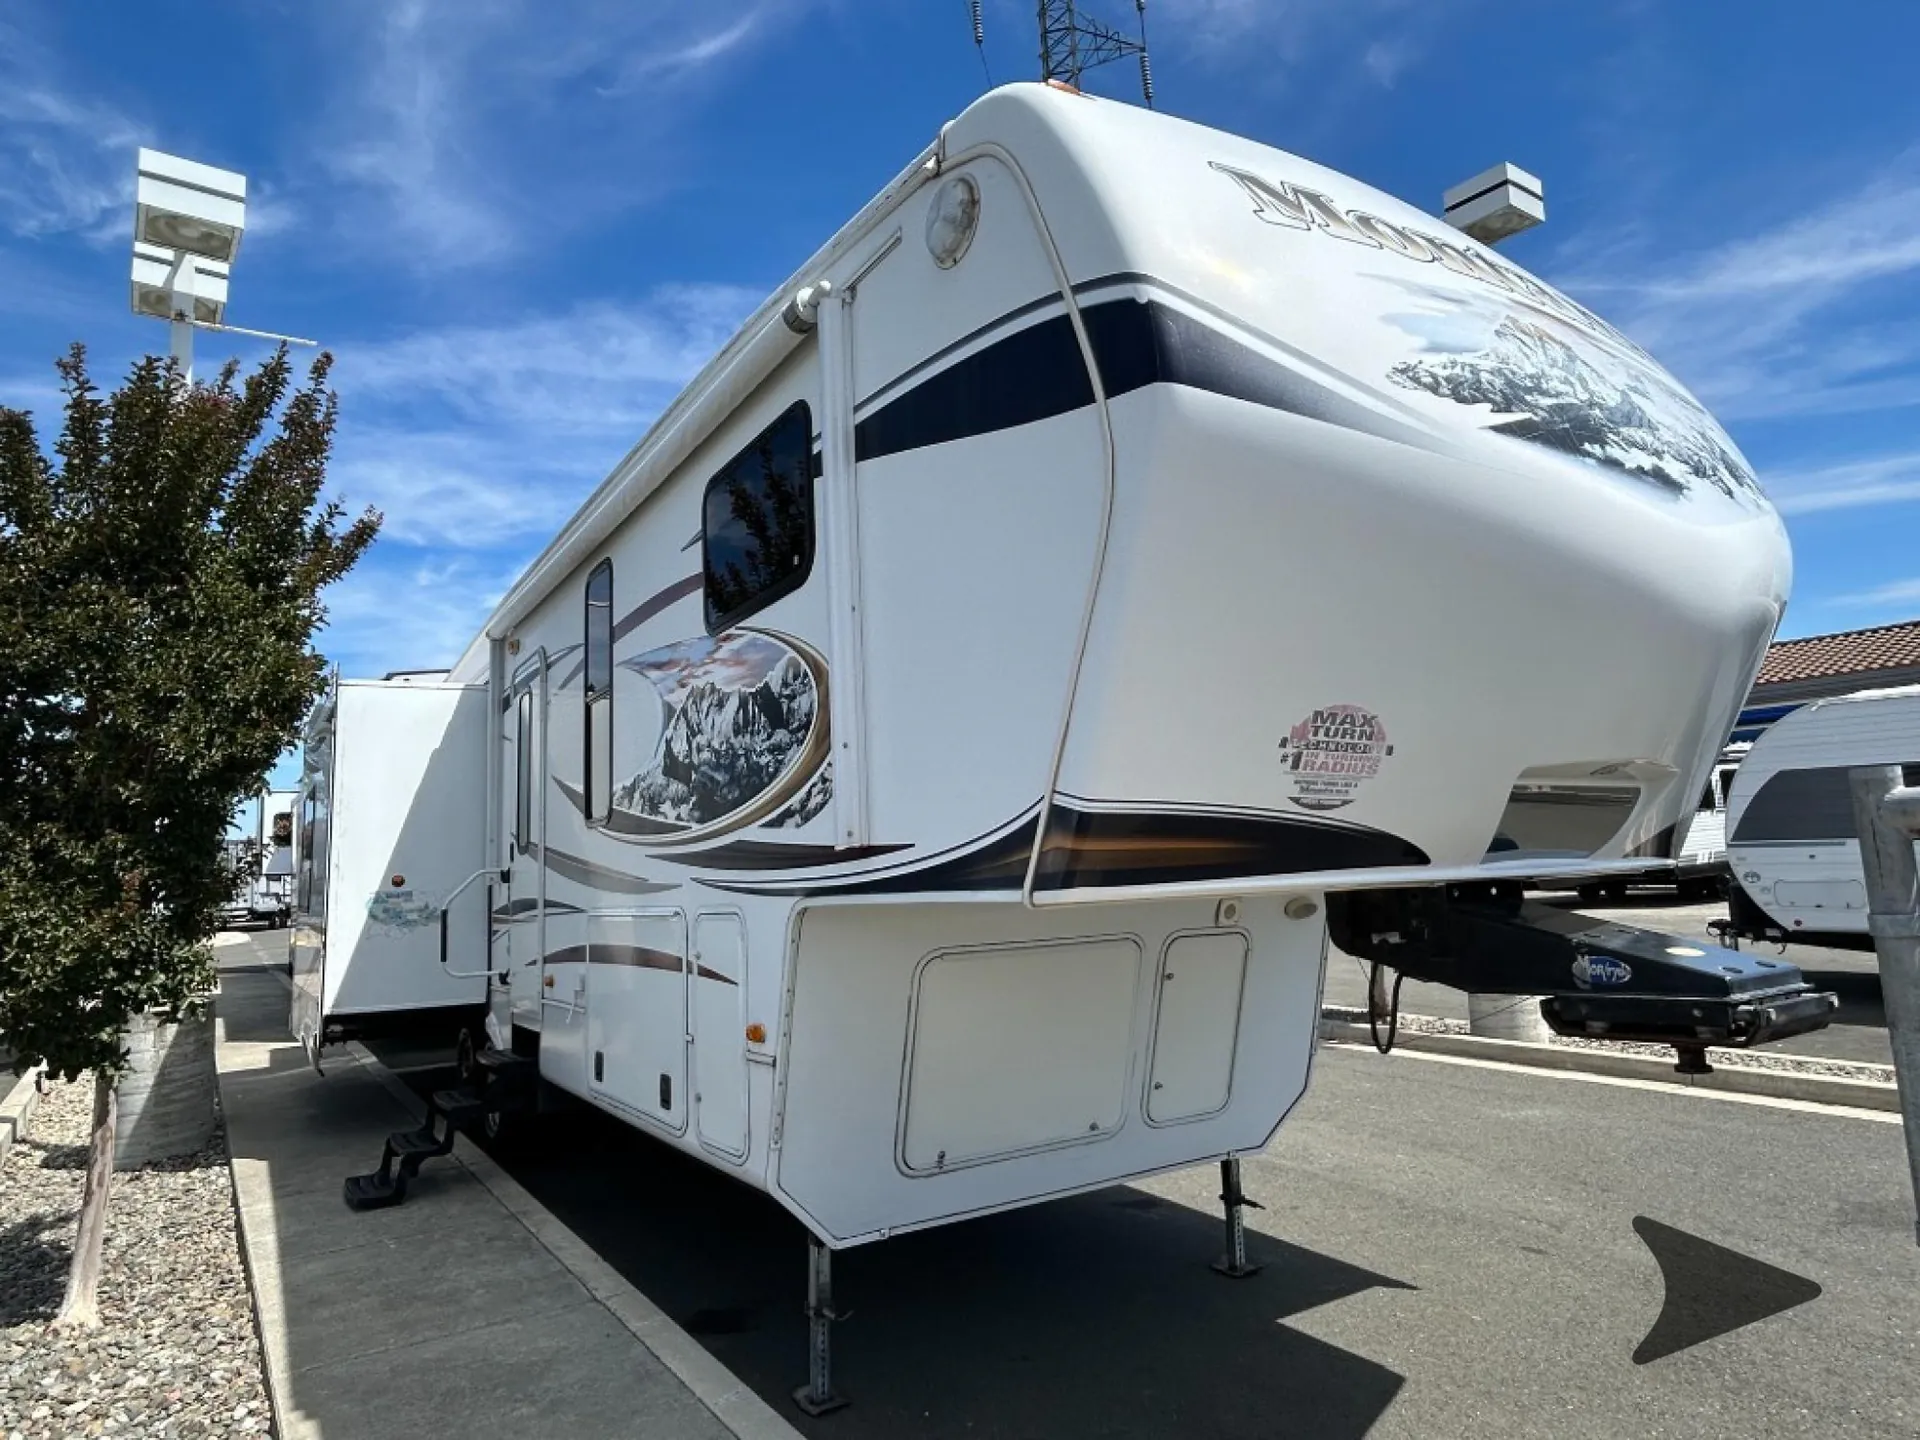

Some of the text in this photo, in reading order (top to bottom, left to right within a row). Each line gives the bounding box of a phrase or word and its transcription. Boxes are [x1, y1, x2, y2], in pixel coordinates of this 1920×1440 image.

[1311, 710, 1378, 728] MAX
[1310, 725, 1374, 741] TURN
[1280, 751, 1303, 771] #1
[1301, 760, 1379, 775] RADIUS
